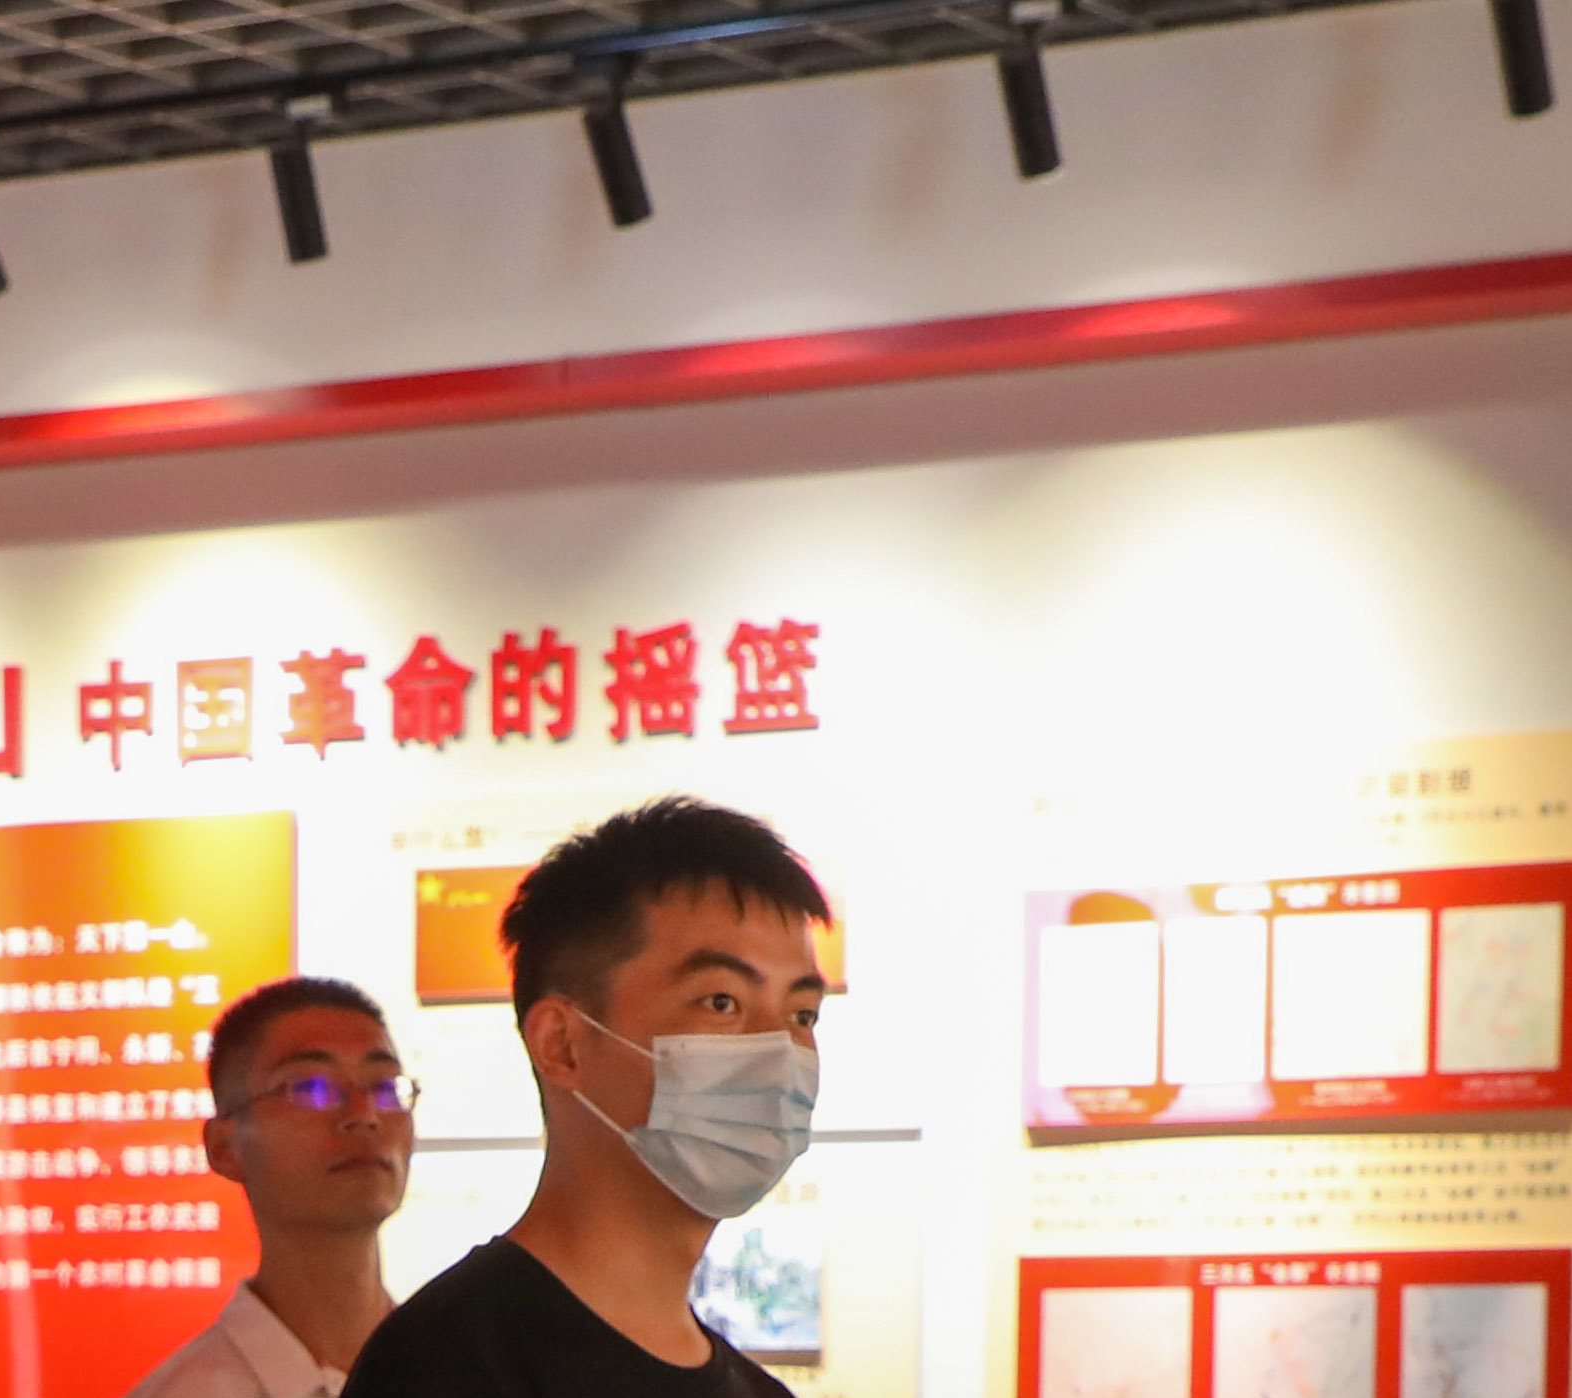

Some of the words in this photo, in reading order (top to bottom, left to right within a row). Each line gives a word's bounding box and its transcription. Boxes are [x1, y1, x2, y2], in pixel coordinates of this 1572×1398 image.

[78, 617, 821, 771] 中国革命的摇篮
